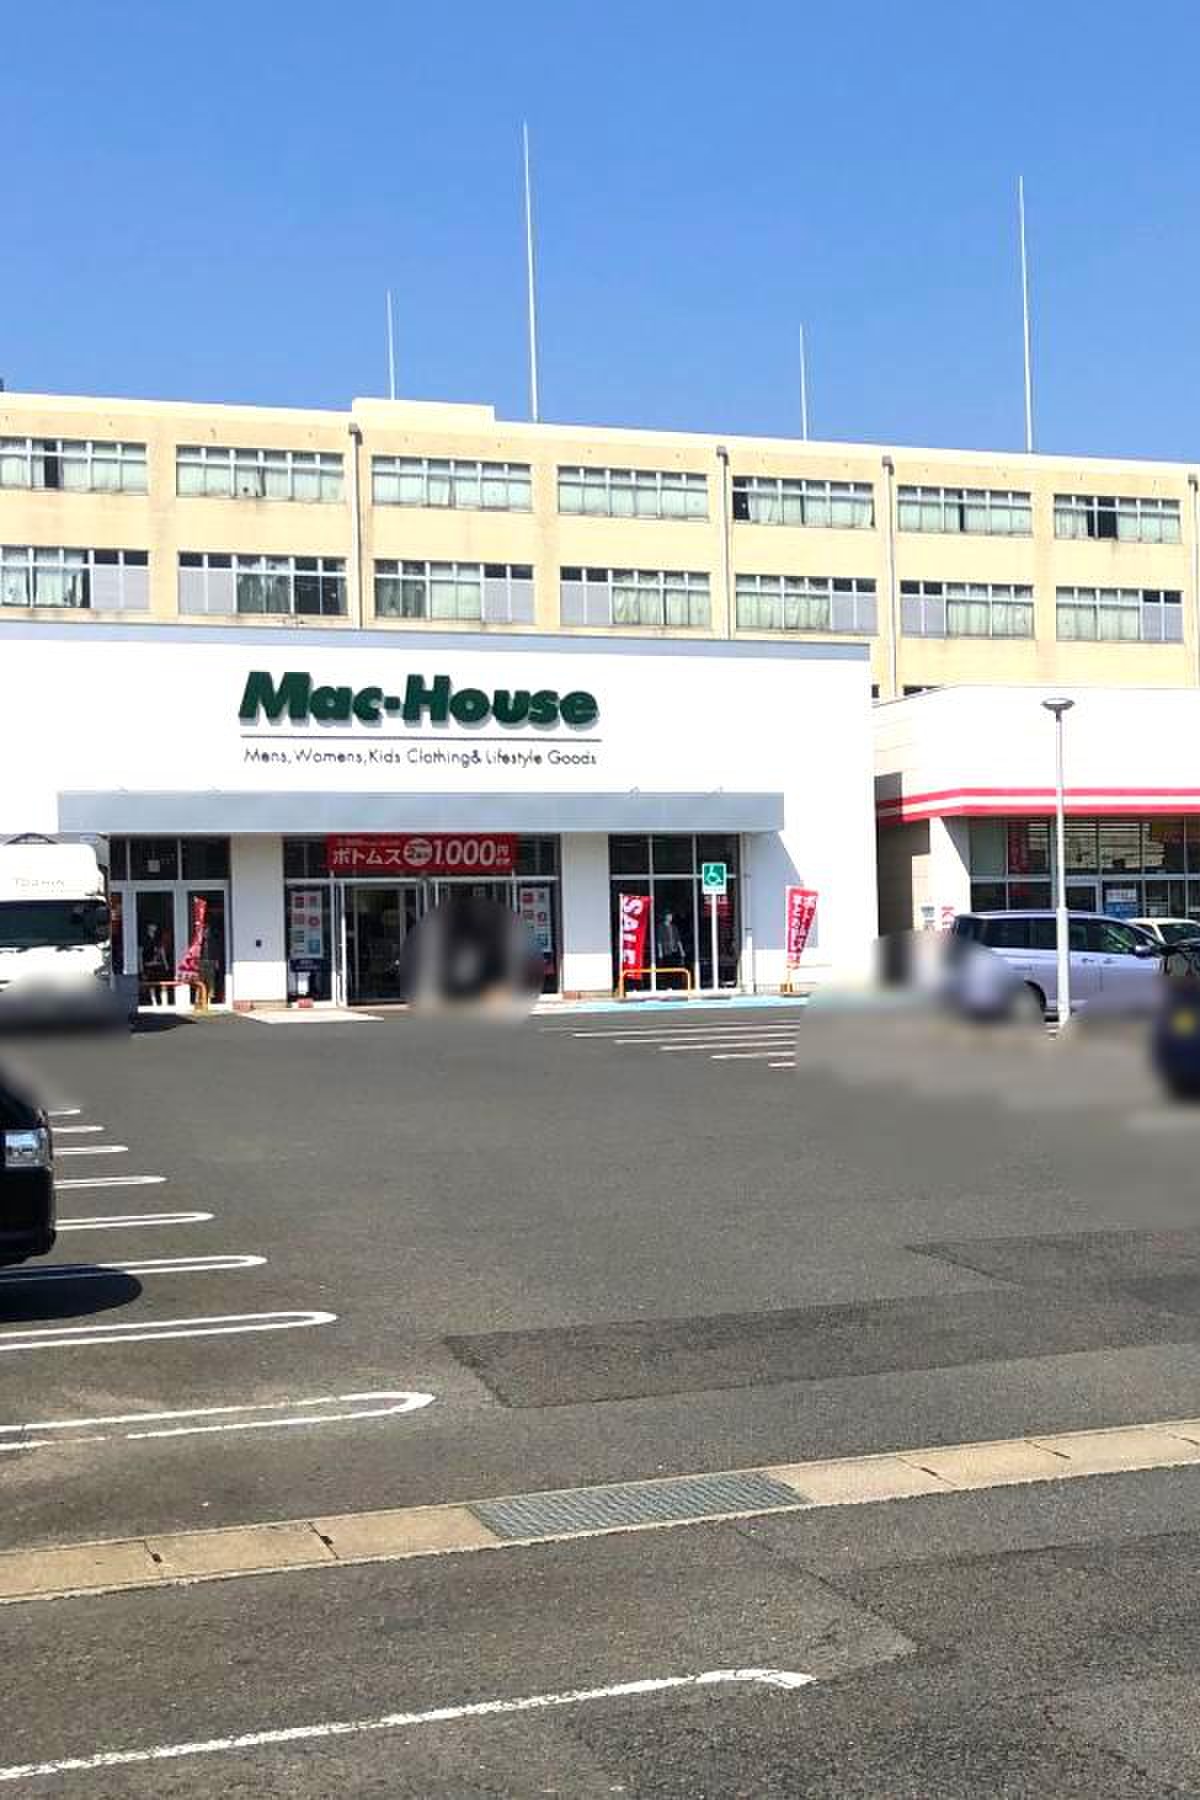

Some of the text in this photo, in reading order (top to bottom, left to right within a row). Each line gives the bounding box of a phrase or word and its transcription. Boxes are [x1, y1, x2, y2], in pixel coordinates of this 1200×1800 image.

[239, 670, 599, 725] Mac-House
[486, 748, 543, 769] Lifestyle
[547, 750, 597, 765] Goods
[333, 847, 401, 865] ボトムス
